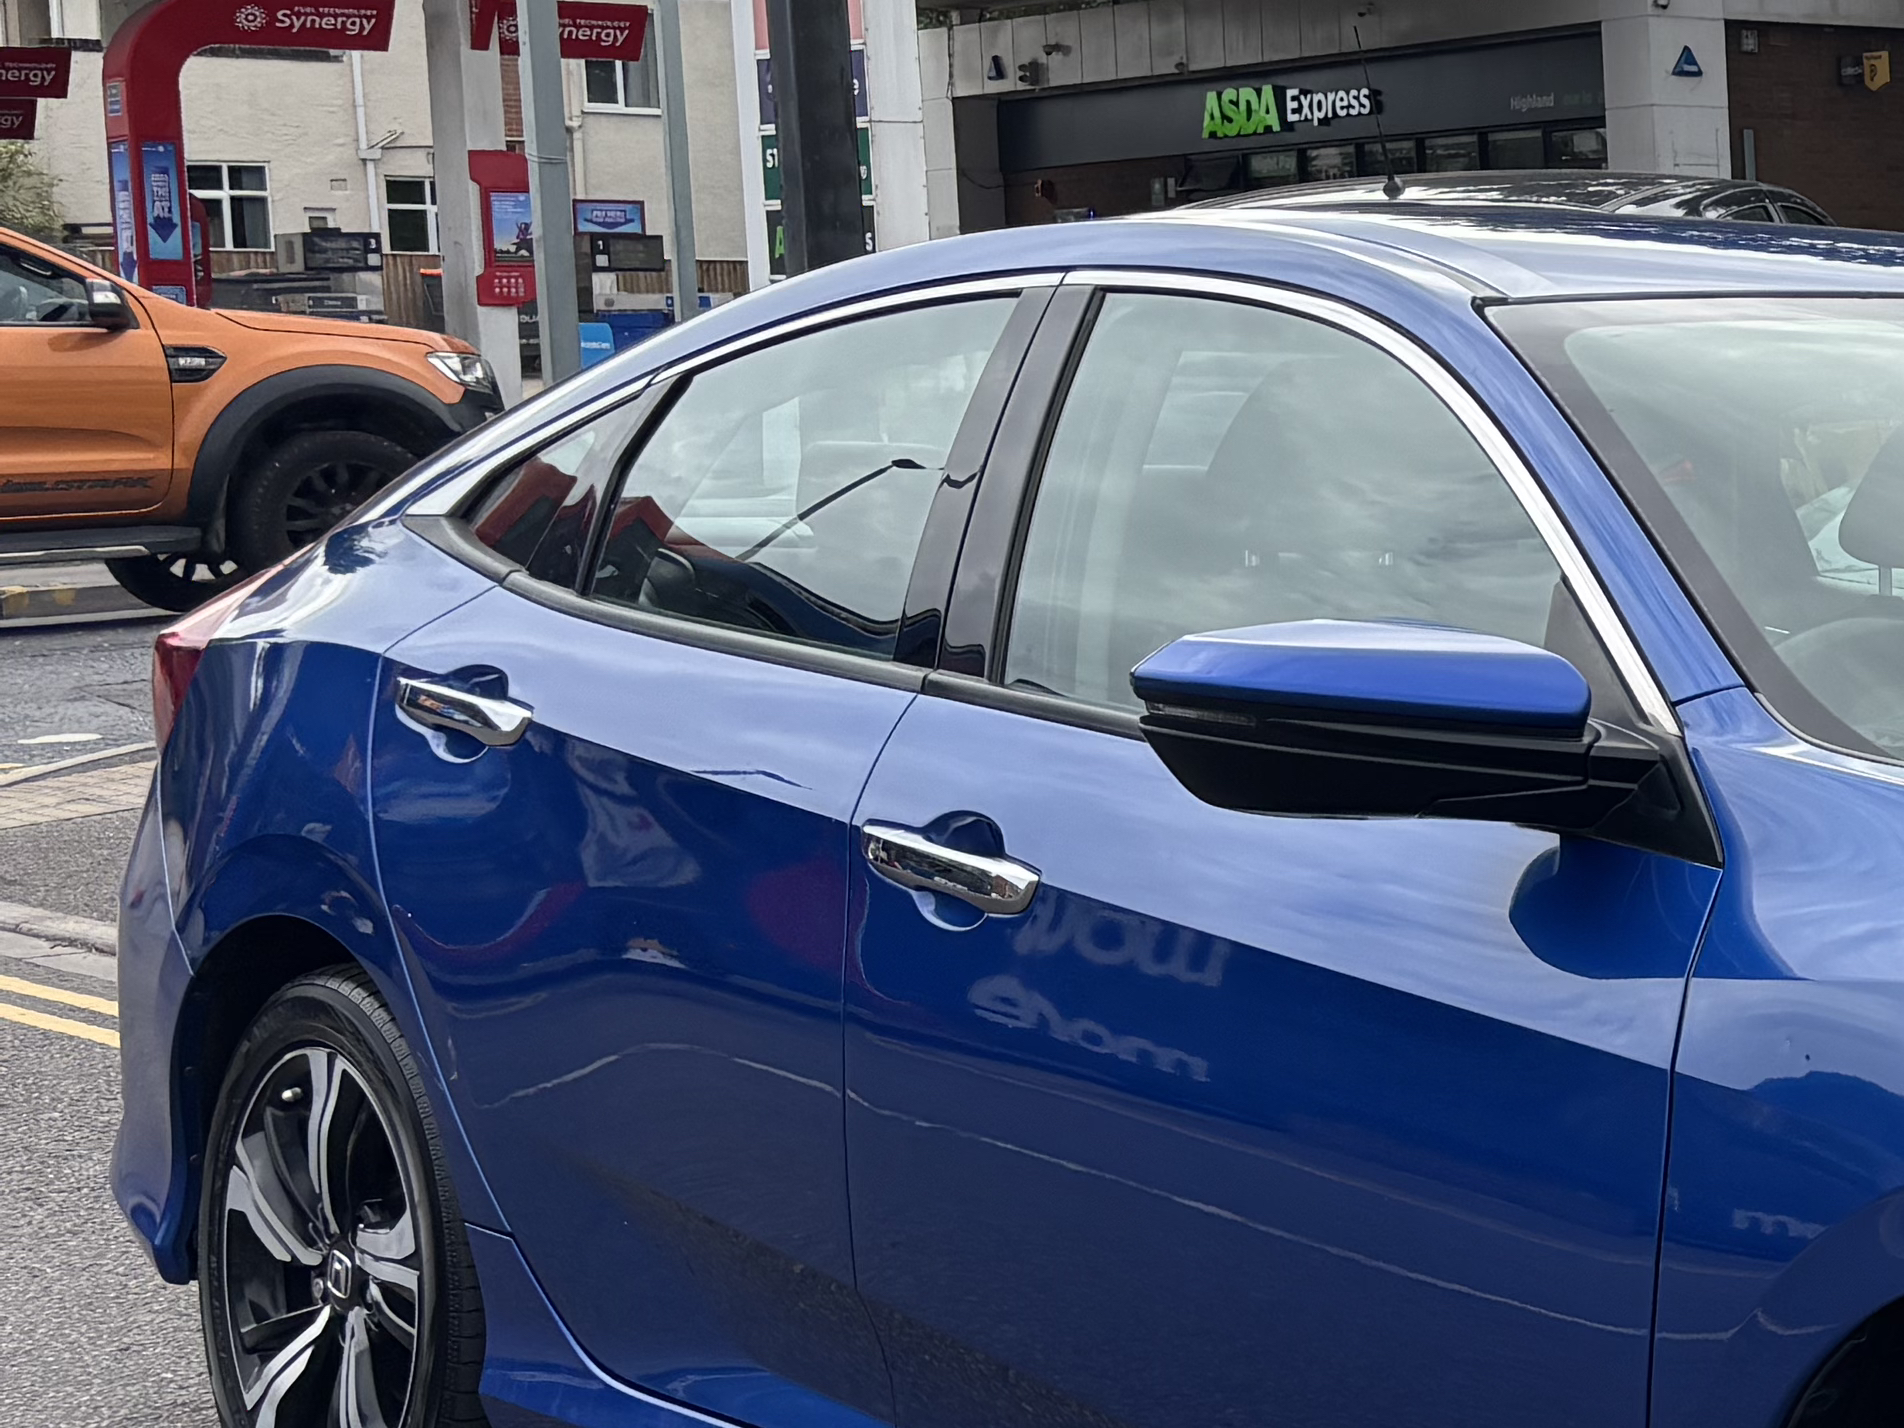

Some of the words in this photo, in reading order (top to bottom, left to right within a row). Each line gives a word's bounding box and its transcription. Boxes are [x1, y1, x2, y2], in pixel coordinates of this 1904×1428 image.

[275, 10, 376, 36] Synergy
[559, 26, 629, 47] nergy
[1202, 84, 1280, 140] ASDA
[1286, 88, 1371, 127] Express
[1510, 92, 1555, 111] Highland
